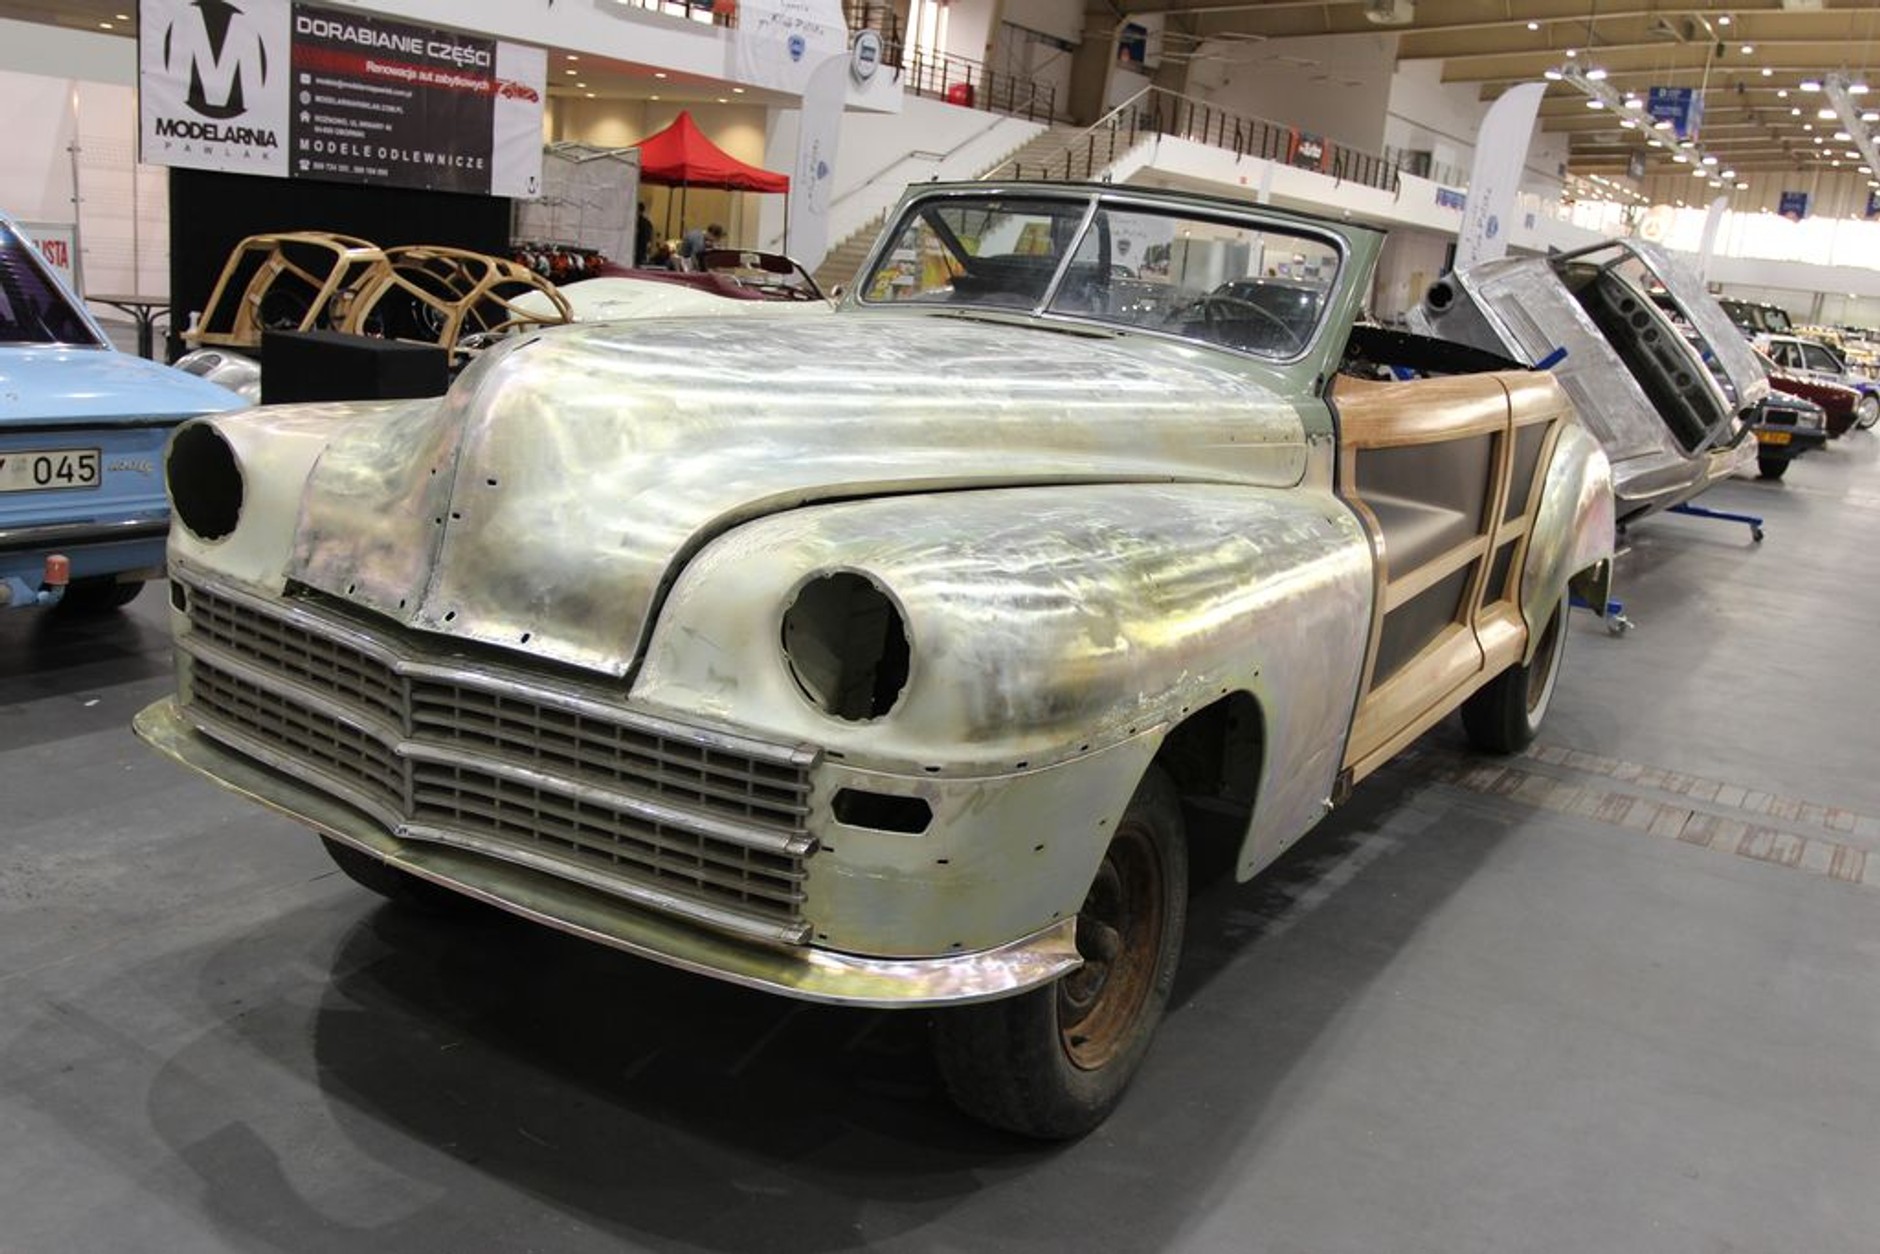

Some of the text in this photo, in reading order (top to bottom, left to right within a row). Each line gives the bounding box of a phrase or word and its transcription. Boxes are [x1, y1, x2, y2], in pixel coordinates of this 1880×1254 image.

[296, 15, 491, 68] DORABIANIE CZĘŚCI
[366, 60, 417, 81] Renowacja
[155, 118, 278, 148] MODELARNIA
[164, 142, 270, 160] PAWLAK
[299, 138, 372, 158] MODELE
[377, 147, 485, 170] ODLEWNICZE
[34, 455, 96, 485] 045
